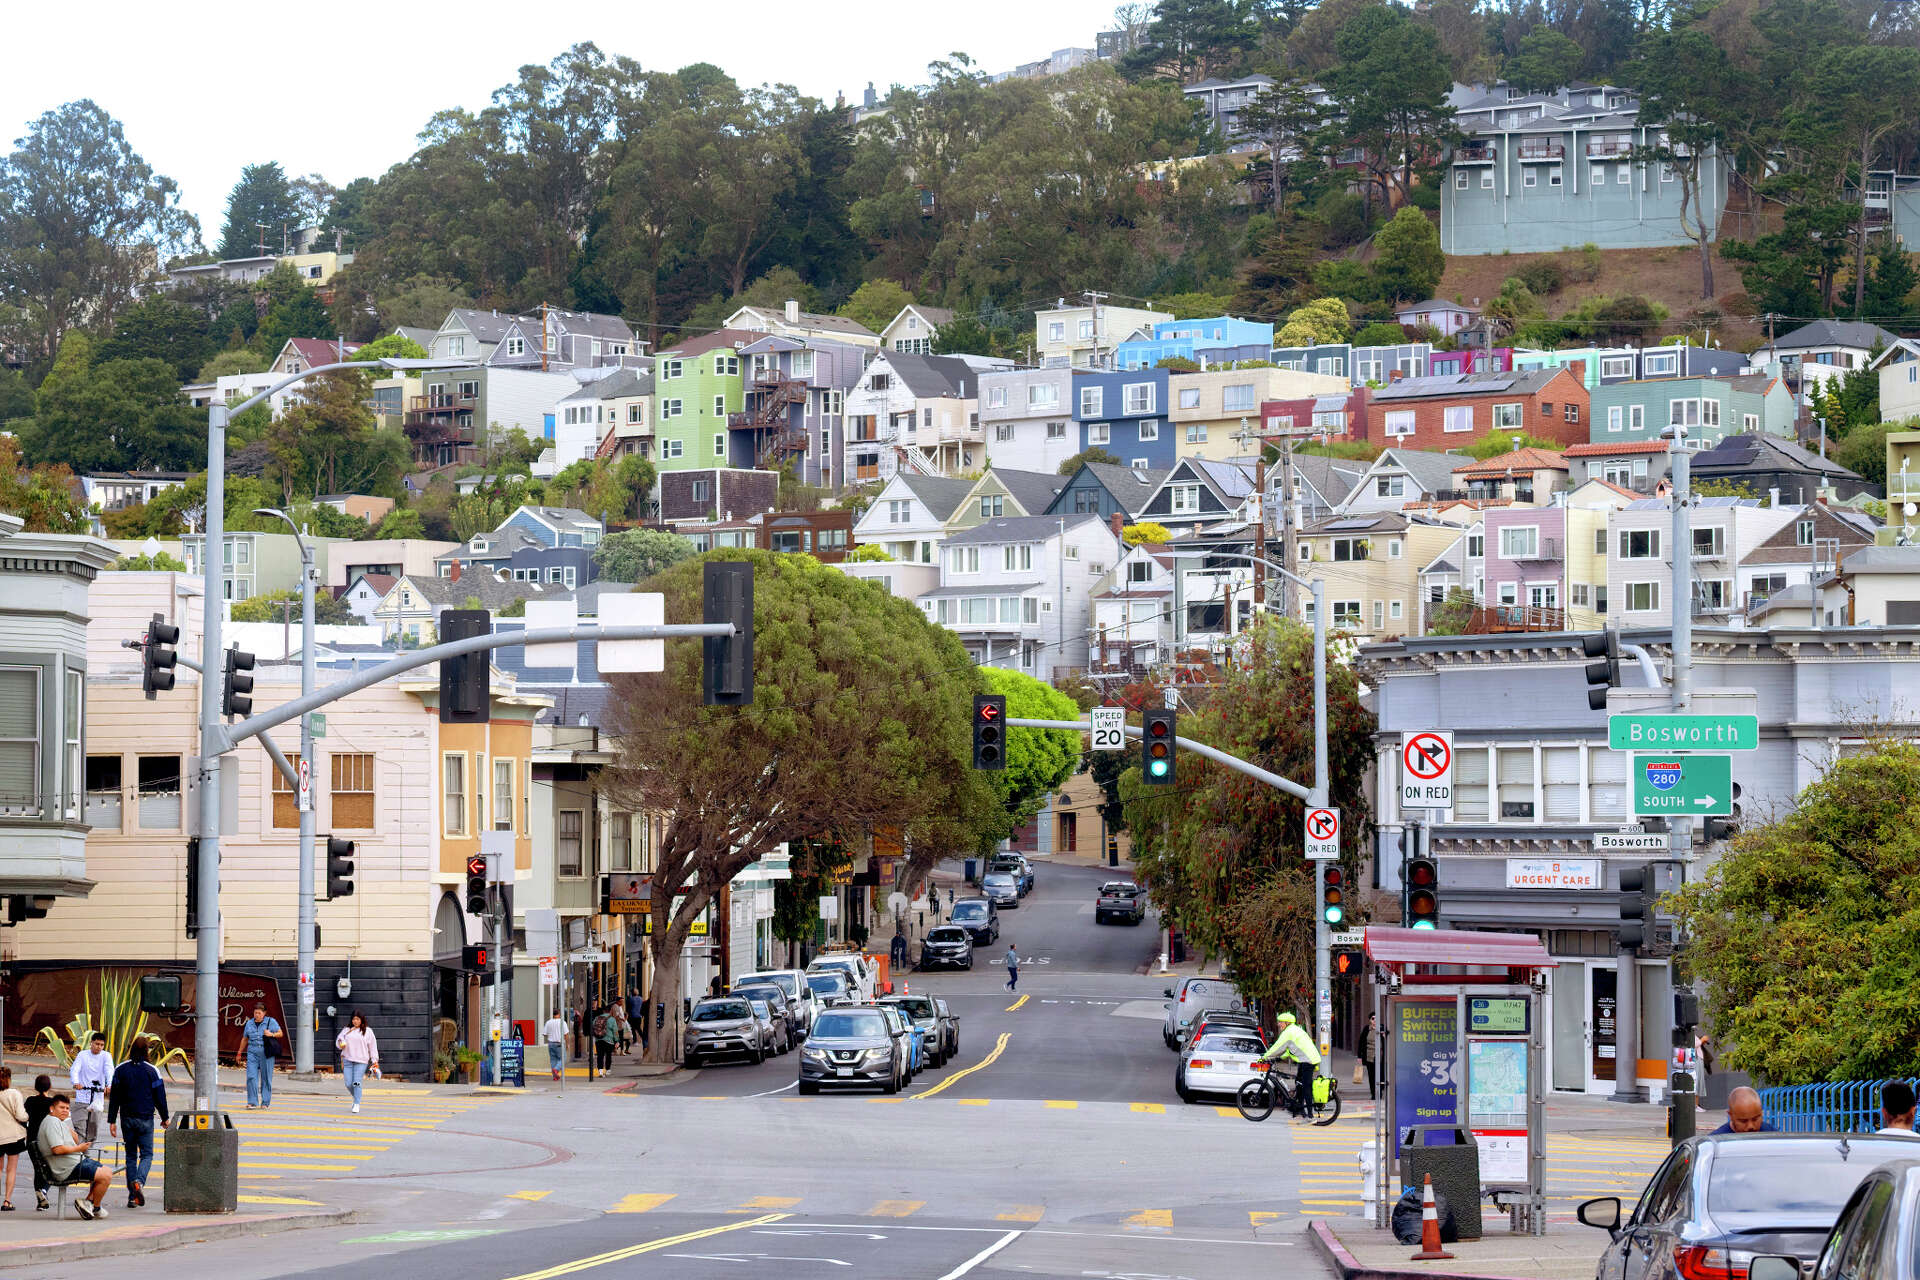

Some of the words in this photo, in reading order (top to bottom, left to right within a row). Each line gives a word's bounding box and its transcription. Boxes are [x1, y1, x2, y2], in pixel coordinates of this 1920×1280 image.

[1095, 730, 1121, 745] 20
[1630, 723, 1738, 742] Bosworth
[1653, 774, 1676, 784] 280
[1405, 787, 1421, 799] ON
[1426, 787, 1449, 799] RED
[1643, 796, 1685, 807] SOUTH
[1602, 837, 1662, 846] Bosworth
[1307, 845, 1318, 853] ON
[1322, 845, 1337, 853] RED
[1514, 875, 1558, 884] URGENT
[1562, 876, 1591, 885] CARE
[477, 951, 486, 965] 18
[219, 986, 255, 998] Welcome
[256, 989, 266, 998] to
[219, 1003, 249, 1027] Par
[1402, 1020, 1447, 1031] Switch
[1402, 1032, 1428, 1042] that
[1430, 1032, 1455, 1043] just
[1433, 1051, 1447, 1060] Gig
[1416, 1107, 1437, 1117] Sign
[1439, 1109, 1452, 1117] up
